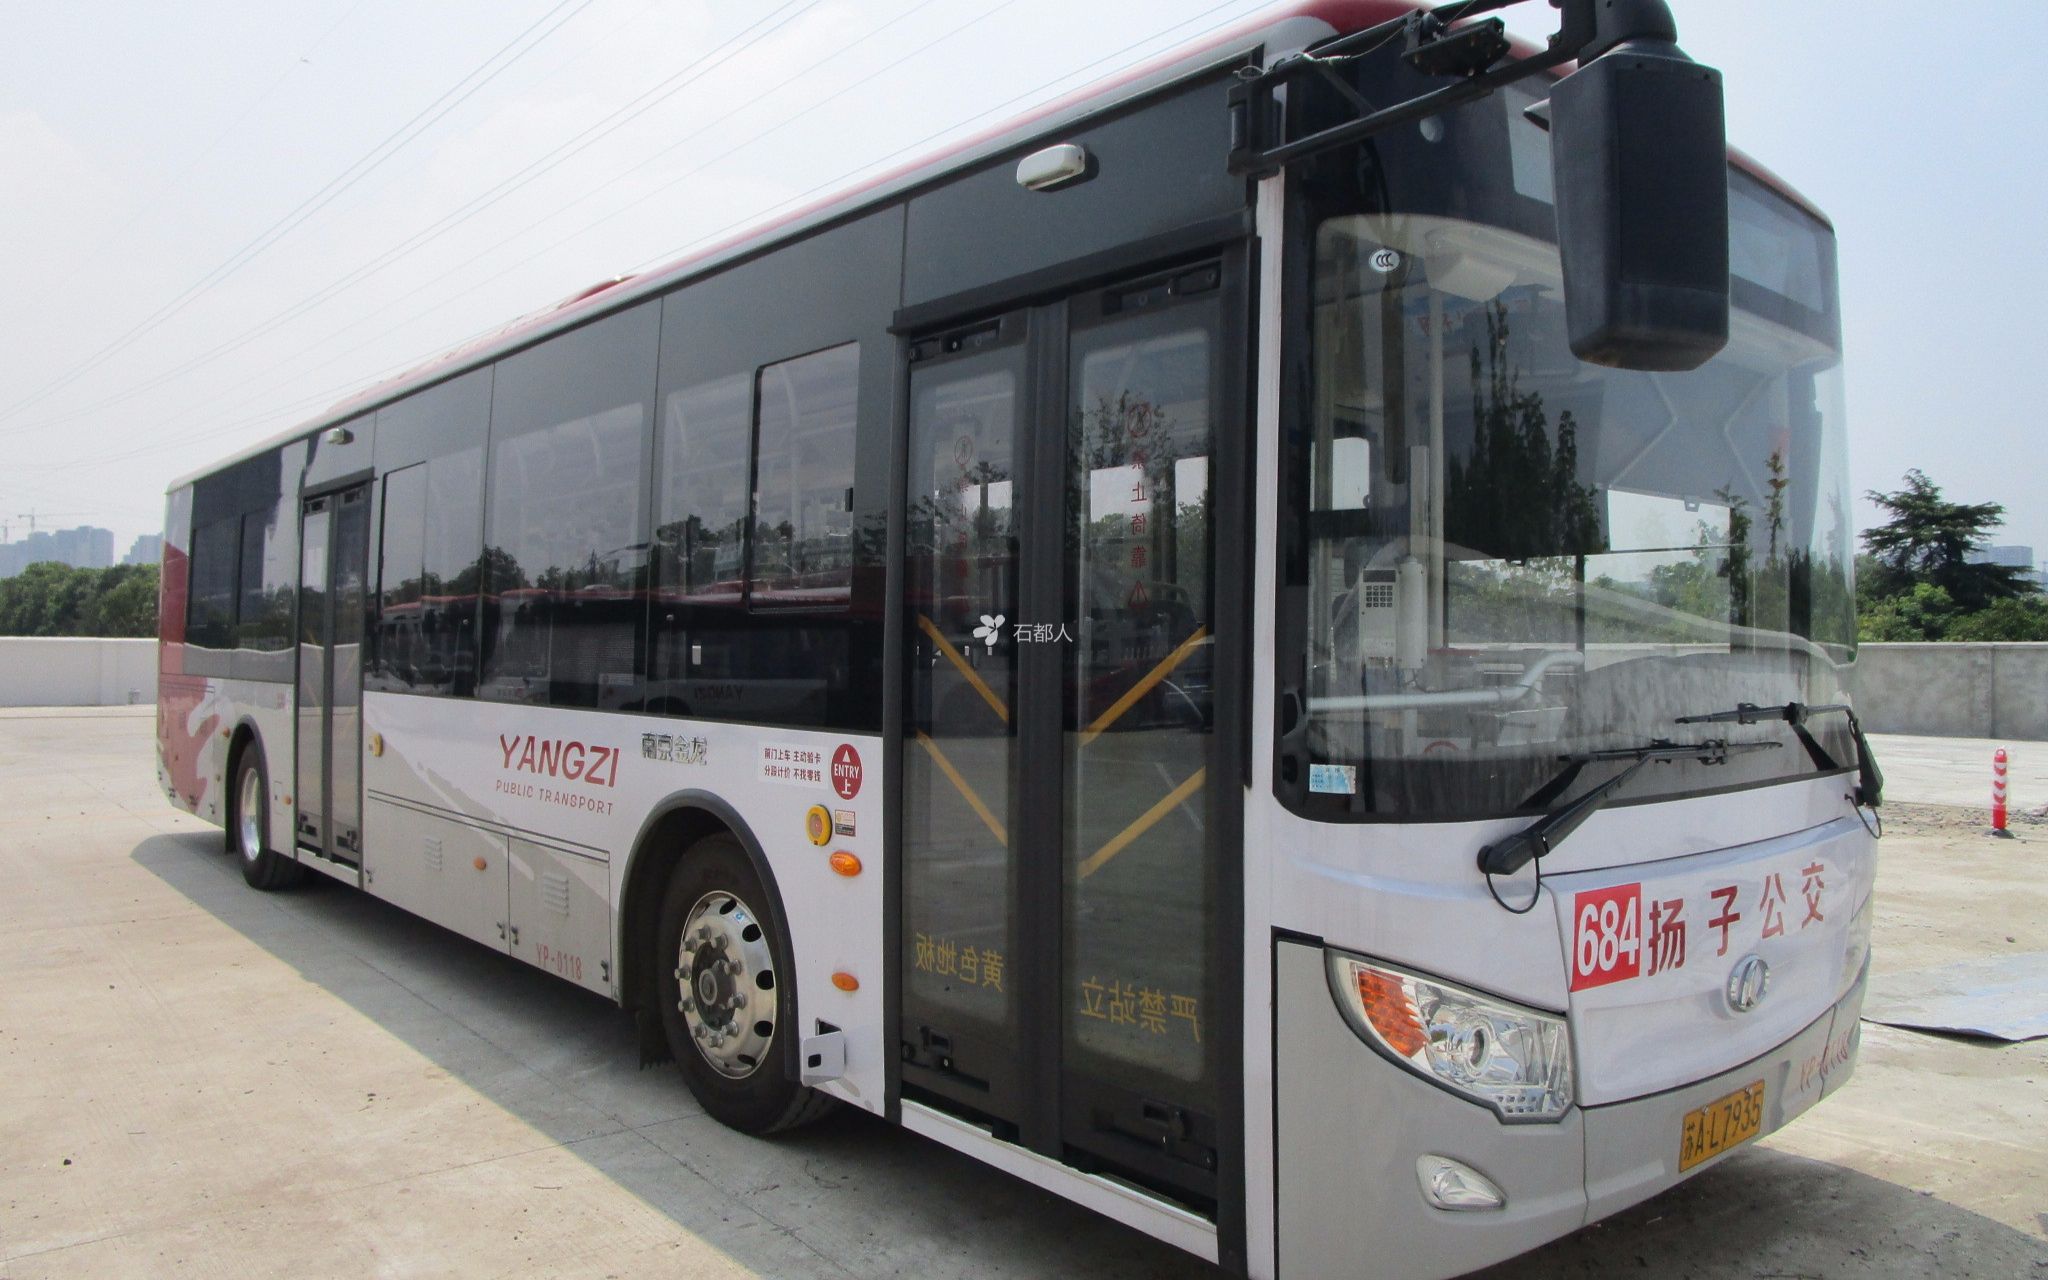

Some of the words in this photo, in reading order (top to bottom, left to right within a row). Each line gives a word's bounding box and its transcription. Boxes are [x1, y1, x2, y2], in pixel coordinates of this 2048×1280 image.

[499, 733, 620, 788] YANGZI
[641, 732, 708, 766] 南京金龙
[764, 747, 791, 761] 前门上车
[793, 768, 822, 782] 不找零钱
[834, 763, 860, 779] ENTRY
[841, 778, 852, 795] 上
[496, 779, 534, 799] PUBLIC
[539, 788, 614, 816] TRANSPORT
[1577, 895, 1640, 977] 684
[1647, 861, 1826, 977] 扬子公交
[536, 942, 582, 980] YP-0118
